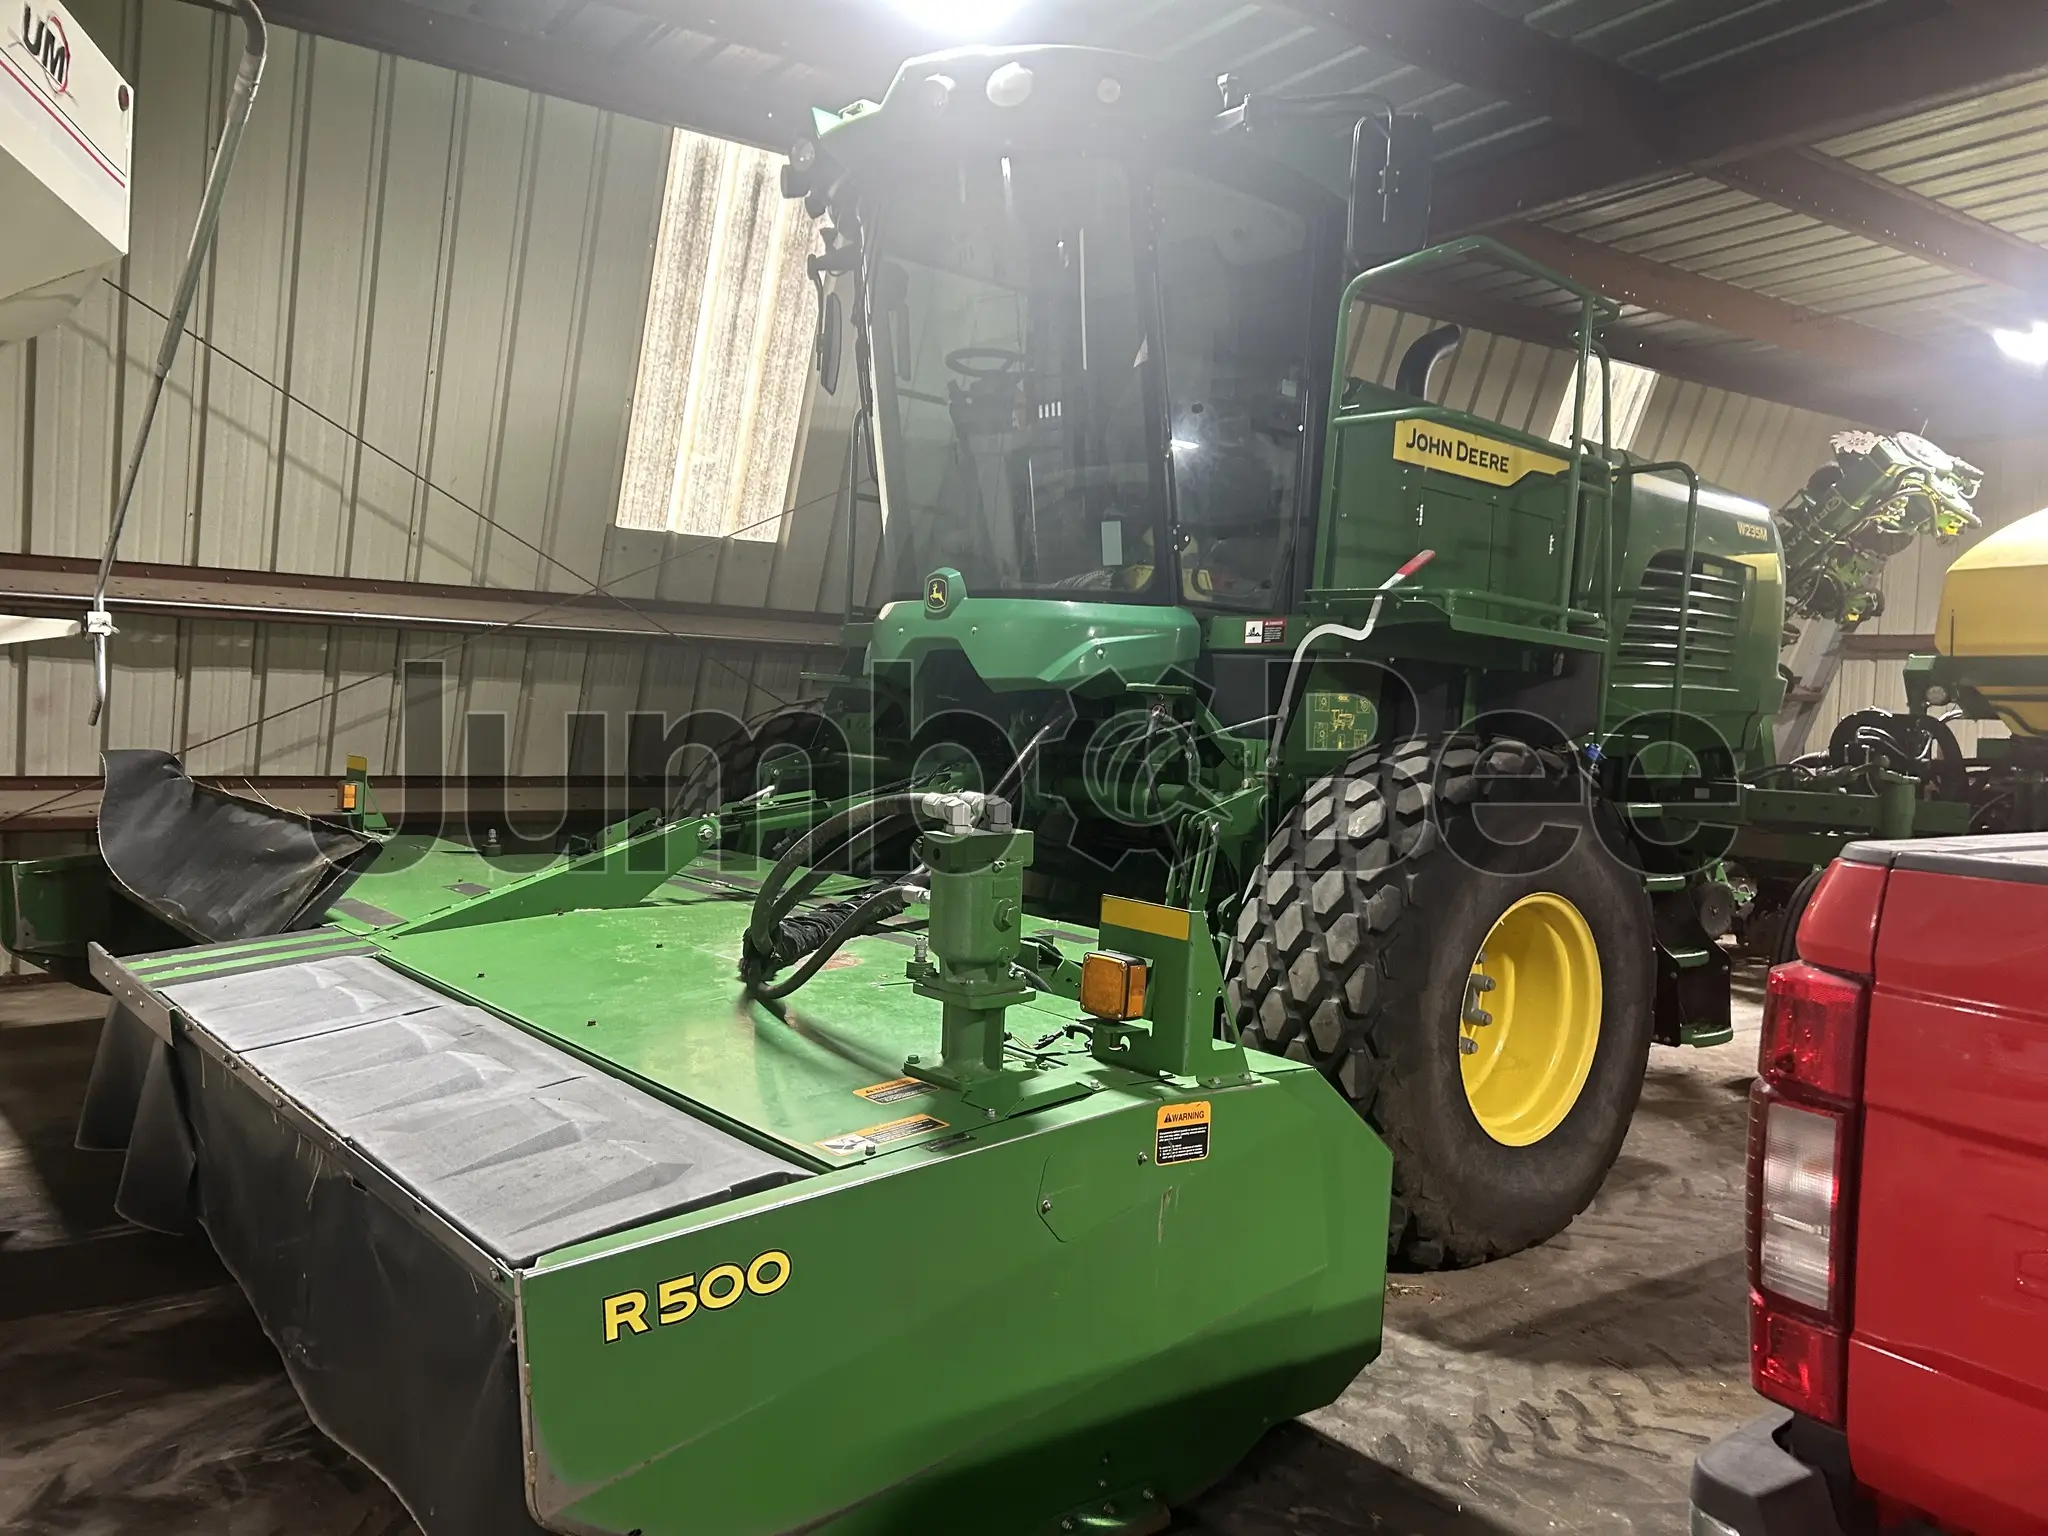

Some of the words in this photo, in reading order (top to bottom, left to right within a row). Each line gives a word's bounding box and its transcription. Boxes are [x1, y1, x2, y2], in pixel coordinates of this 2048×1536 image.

[1406, 428, 1453, 460] JOHN
[1456, 440, 1510, 474] DEERE
[1171, 1110, 1205, 1122] WARNING
